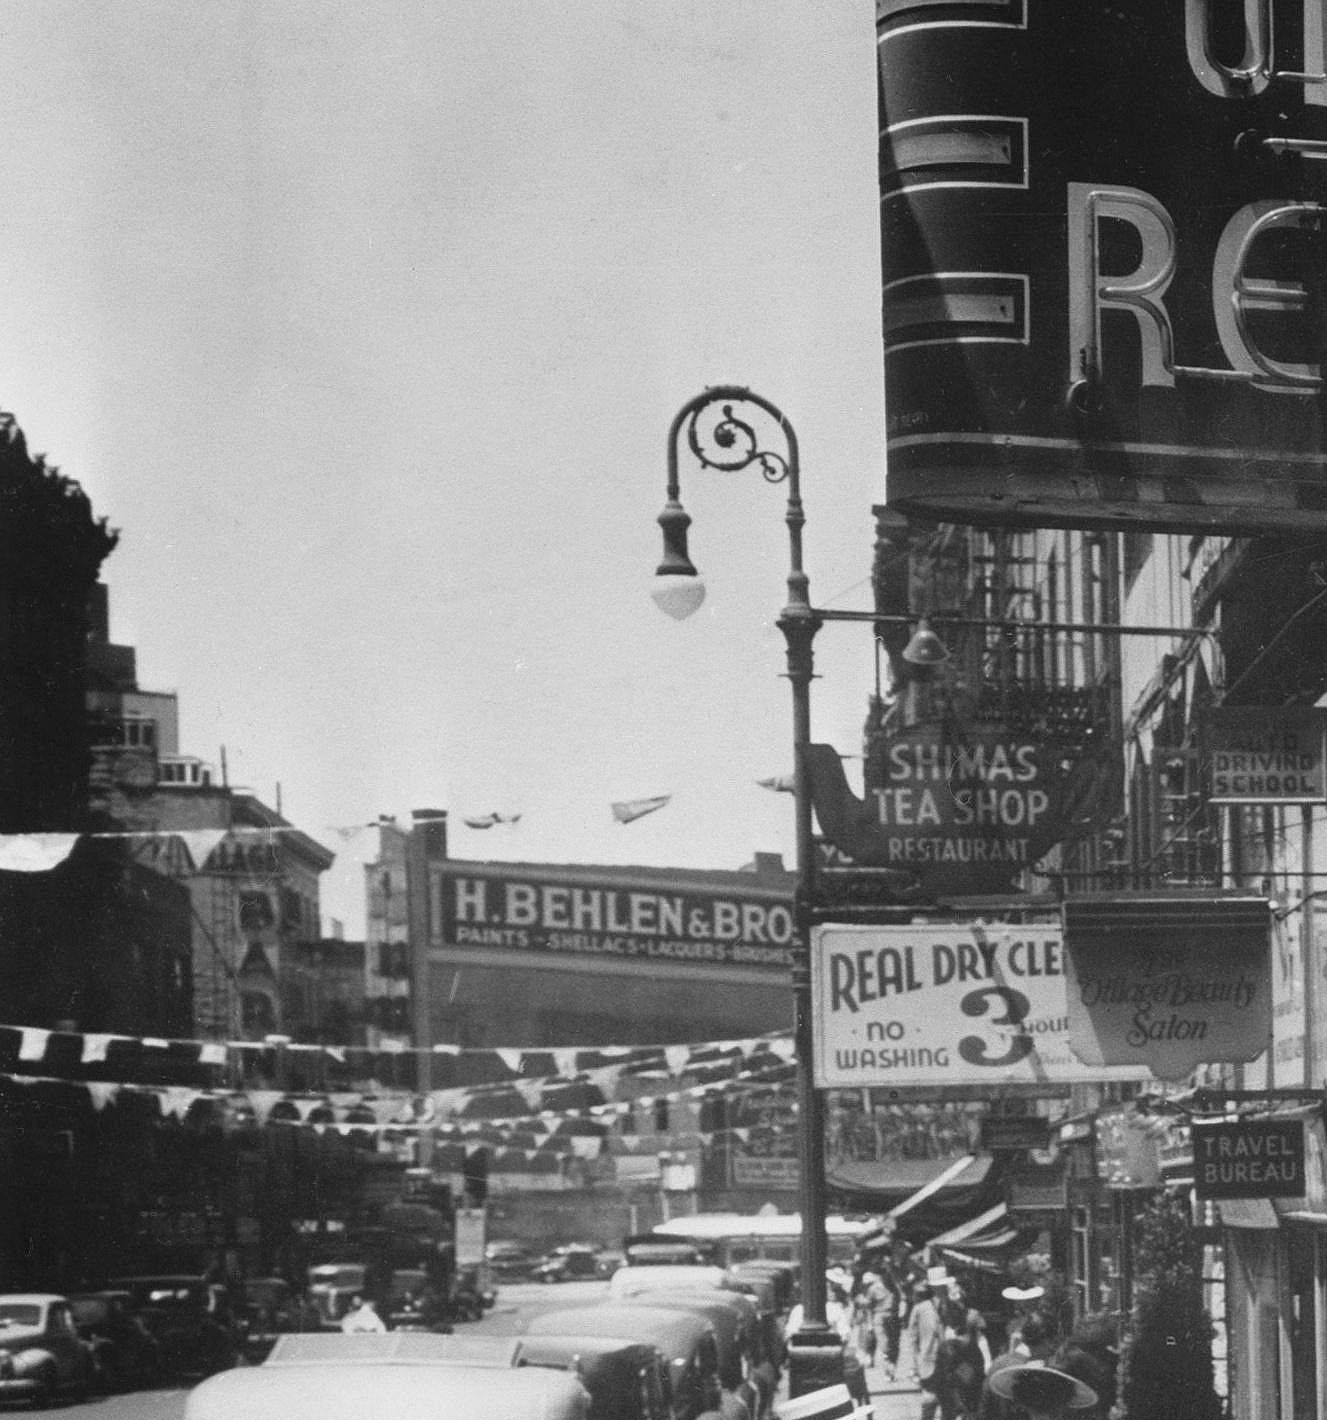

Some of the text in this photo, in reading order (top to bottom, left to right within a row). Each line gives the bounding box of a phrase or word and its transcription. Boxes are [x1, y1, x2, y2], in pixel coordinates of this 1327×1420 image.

[889, 744, 1038, 782] SHIMA'S
[1216, 753, 1314, 772] DRIVING
[1216, 775, 1317, 794] SCHOOL
[872, 788, 1049, 826] TEA SHOP
[888, 838, 1030, 862] RESTAURANT
[504, 883, 684, 936] BEHLEN
[713, 902, 797, 944] BRO
[456, 927, 528, 946] PAINTS
[830, 940, 1066, 1013] REAL DRY CLE
[958, 986, 1034, 1067] 3
[1125, 1008, 1209, 1047] Salon
[835, 1047, 949, 1070] WASHING
[1204, 1136, 1296, 1156] TRAVEL
[1205, 1162, 1298, 1183] BUREAU
